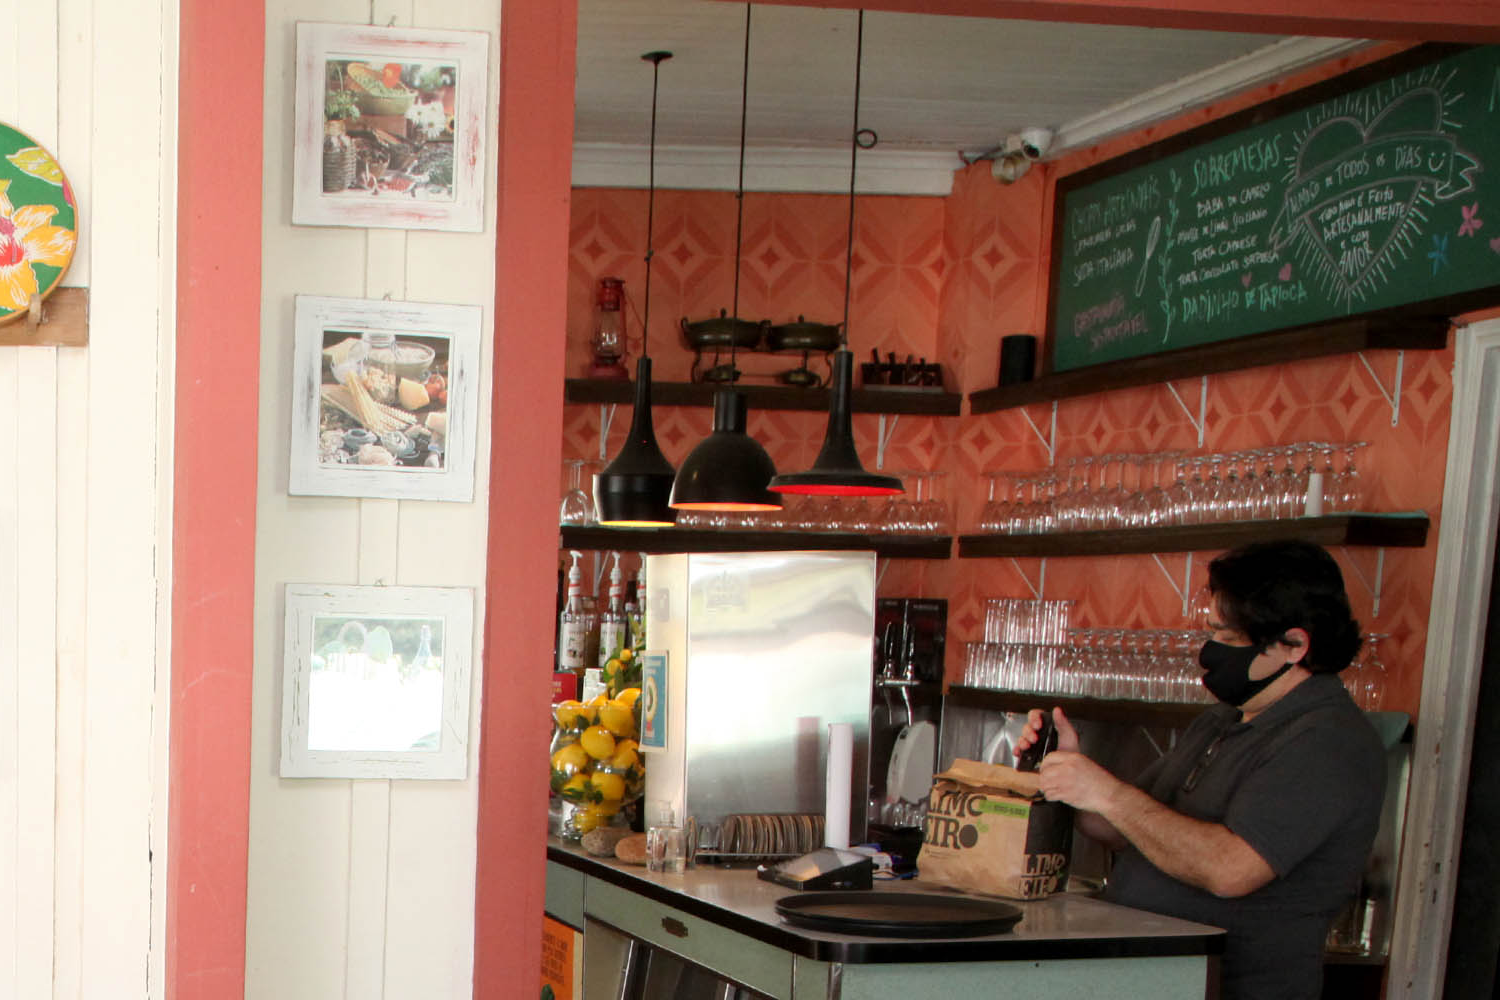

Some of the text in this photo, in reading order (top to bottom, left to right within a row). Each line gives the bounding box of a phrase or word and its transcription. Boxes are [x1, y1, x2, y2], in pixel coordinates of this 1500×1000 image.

[1190, 134, 1281, 197] SOBREMESAS
[1336, 153, 1370, 184] TODOS
[1323, 202, 1406, 240] ARTESANALMENTE
[1340, 241, 1374, 276] AMOR
[1258, 281, 1307, 312] TAPIOCA
